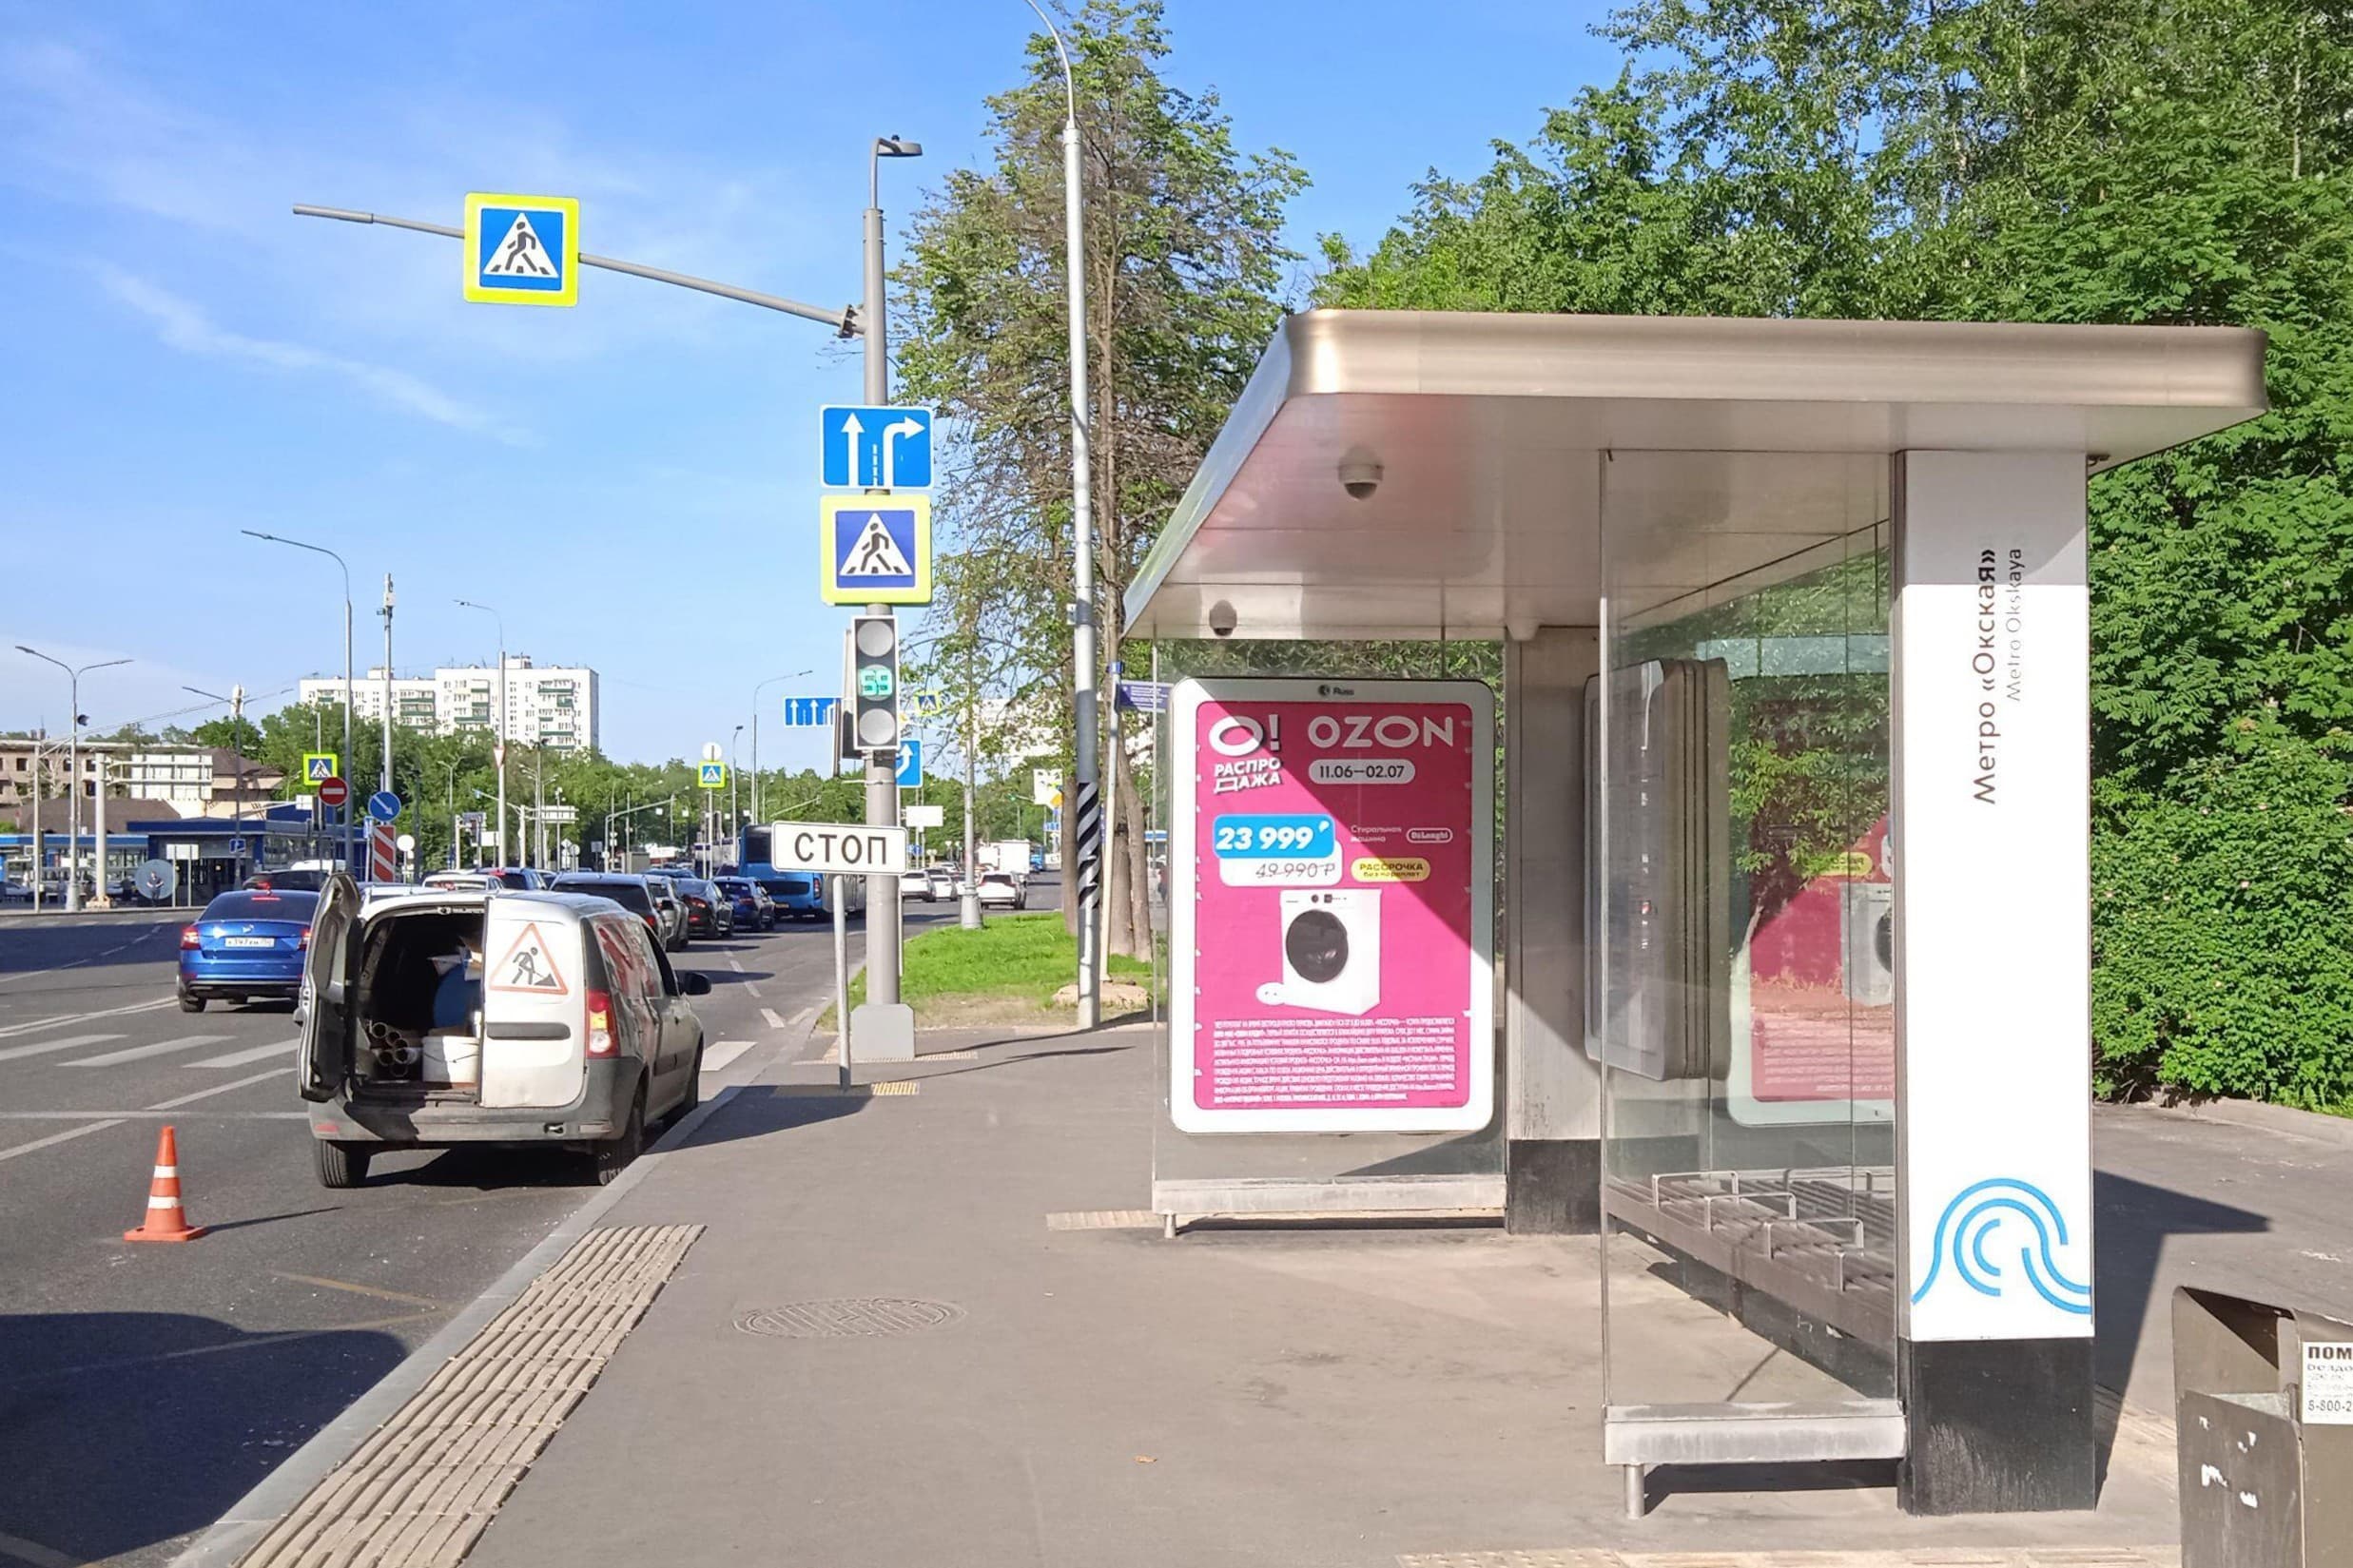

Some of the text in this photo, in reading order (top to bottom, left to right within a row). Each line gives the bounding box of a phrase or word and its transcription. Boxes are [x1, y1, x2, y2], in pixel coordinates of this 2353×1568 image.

[2005, 549, 2026, 702] Metro Okskaya
[1972, 549, 2001, 804] Метро «Окская»
[1209, 713, 1280, 757] О!
[1308, 715, 1454, 748] OZON
[1215, 757, 1281, 777] РАСПРО
[1214, 771, 1281, 795] ДАЖА
[794, 832, 886, 864] СТОП
[1215, 826, 1253, 851] 23
[1258, 826, 1314, 851] 999
[1284, 862, 1318, 878] 990
[2307, 1345, 2353, 1361] ПОМ
